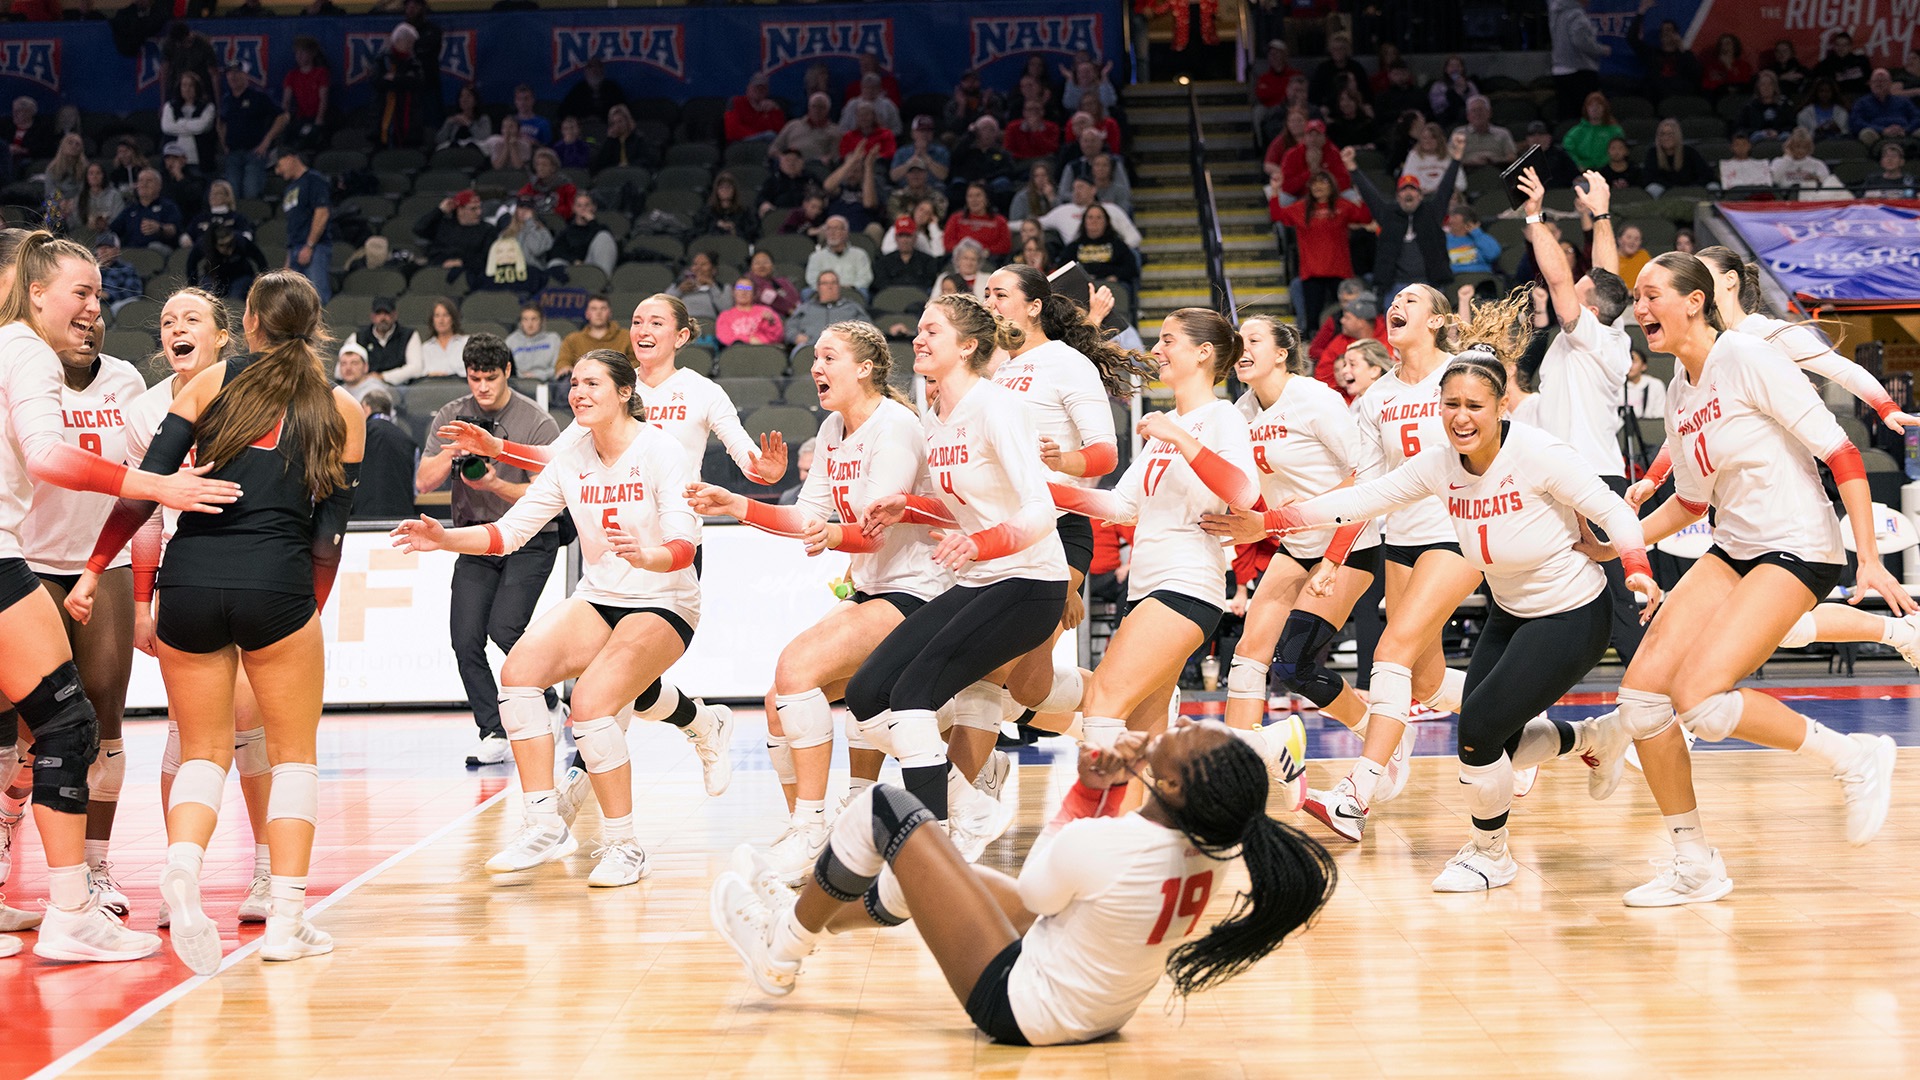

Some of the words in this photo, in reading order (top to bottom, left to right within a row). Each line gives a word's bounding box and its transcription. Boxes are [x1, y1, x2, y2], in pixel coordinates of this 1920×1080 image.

[1784, 0, 1878, 29] RIGHT
[1891, 0, 1920, 25] W
[349, 32, 475, 81] NA
[556, 28, 682, 77] NAIA
[763, 23, 892, 72] NAIA
[973, 18, 1101, 67] NAIA
[1818, 17, 1916, 66] PAY
[62, 408, 125, 429] LDCATS
[1253, 445, 1275, 474] 8
[1400, 423, 1422, 458] 6
[1694, 431, 1716, 478] 11
[579, 482, 645, 504] WILDCATS
[939, 471, 967, 506] 4
[1143, 458, 1172, 497] 17
[832, 485, 858, 524] 16
[1448, 490, 1524, 520] WILDCATS
[1477, 524, 1494, 565] 1
[1145, 870, 1214, 946] 19
